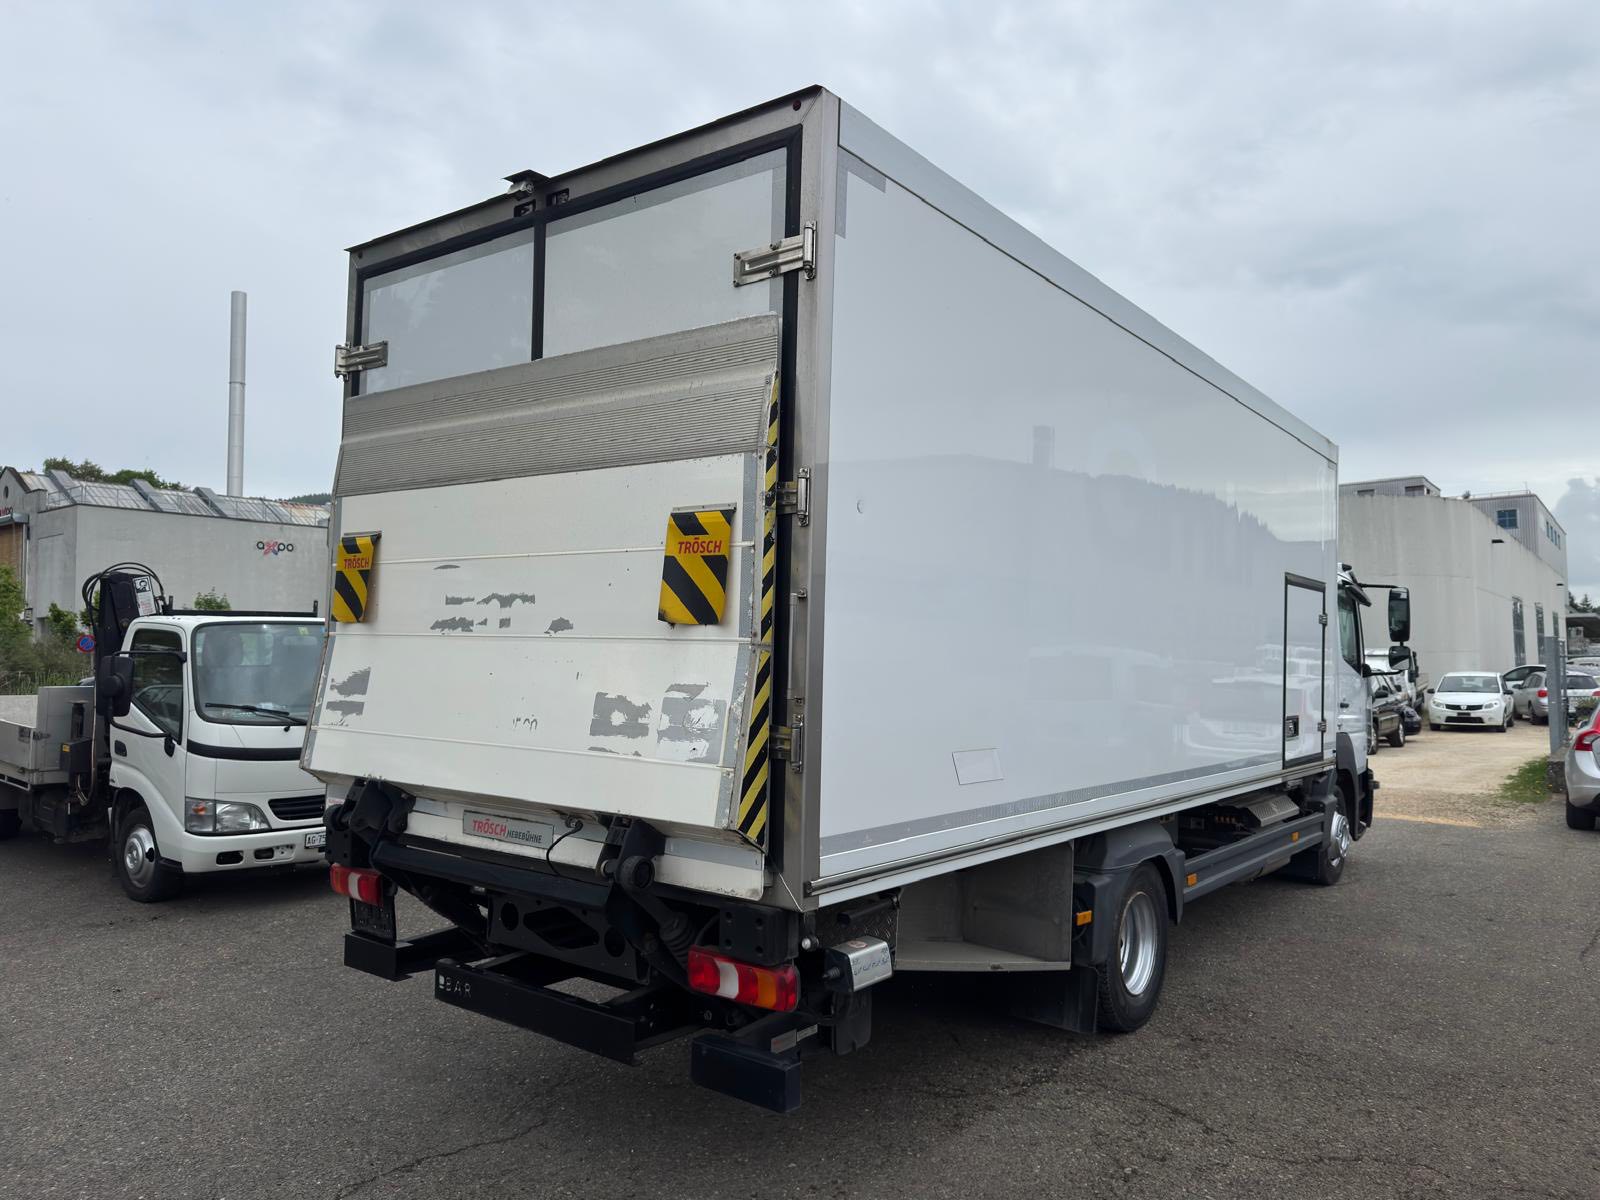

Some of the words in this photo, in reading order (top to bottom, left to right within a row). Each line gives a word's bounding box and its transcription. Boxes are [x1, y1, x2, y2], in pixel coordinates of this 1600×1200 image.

[678, 537, 723, 555] TRÖSCH
[344, 555, 370, 569] TRÖSCH
[473, 818, 507, 837] TRÖSCH
